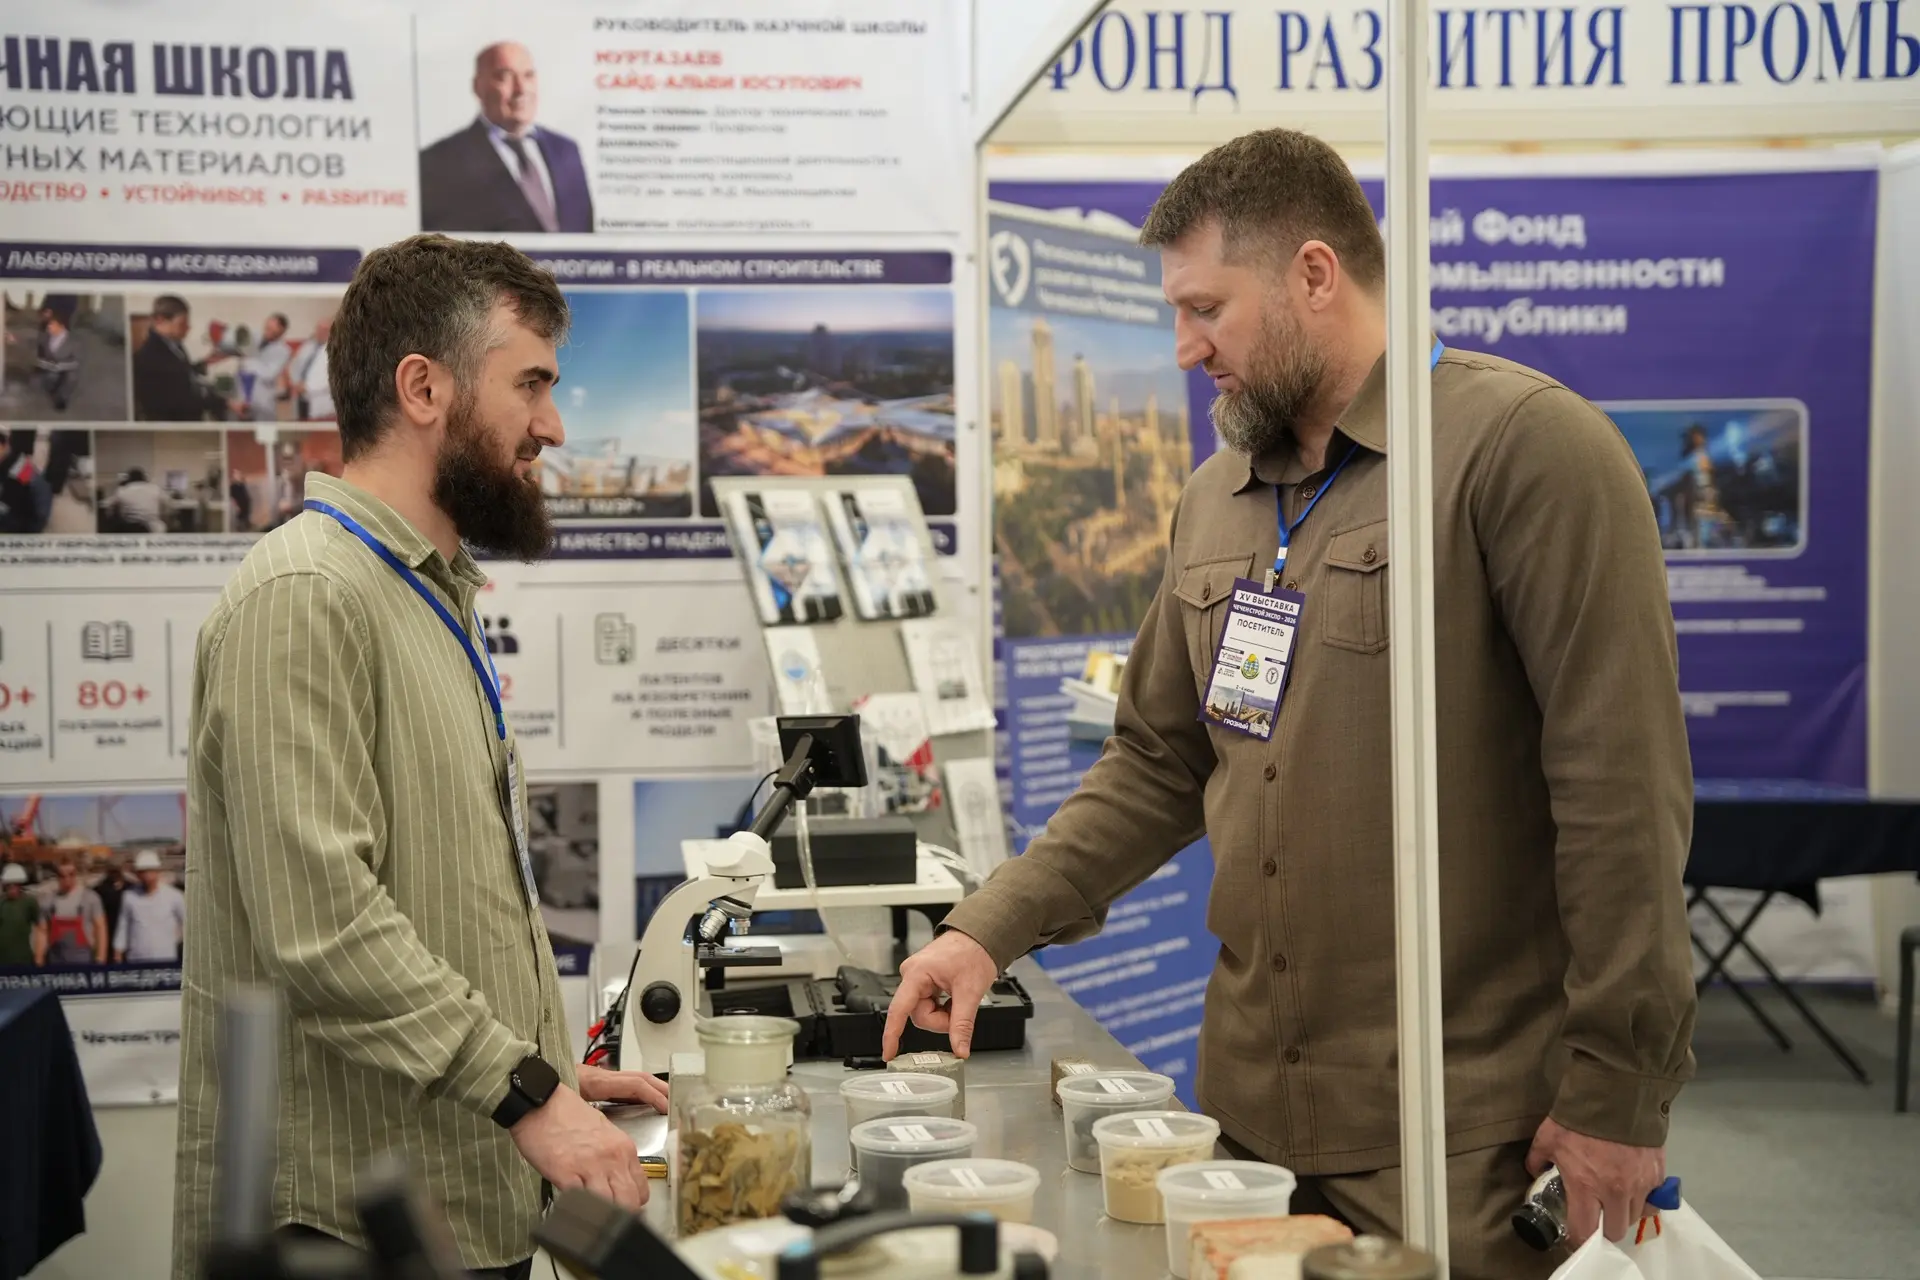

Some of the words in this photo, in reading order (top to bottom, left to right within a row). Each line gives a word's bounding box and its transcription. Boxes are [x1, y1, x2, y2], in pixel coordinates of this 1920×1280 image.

[1276, 5, 1625, 91] РАЗИТИЯ
[152, 42, 355, 101] ШКОЛА
[130, 108, 372, 141] ТЕХНОЛОГИИ
[0, 143, 88, 173] НЫХ
[99, 145, 346, 179] МАТЕРИАЛОВ
[122, 181, 268, 207] УСТОЙЧИВОЕ
[301, 187, 409, 208] РАЗВИТИЕ
[1472, 207, 1587, 249] Фонд
[6, 250, 149, 273] ЛАБОРАТОРИЯ
[165, 253, 319, 276] ИССЛЕДОВАНИЯ
[642, 258, 742, 280] РЕАЛЬНОМ
[744, 258, 886, 280] СТРОИТЕЛЬСТВЕ
[560, 531, 650, 552] КАЧЕСТВО
[1252, 595, 1294, 613] ВЫСТАВКА
[1236, 618, 1285, 637] ПОСЕТИТЕЛЬ
[77, 680, 152, 710] 80+
[1223, 718, 1250, 731] ГРОЗНЫЙ
